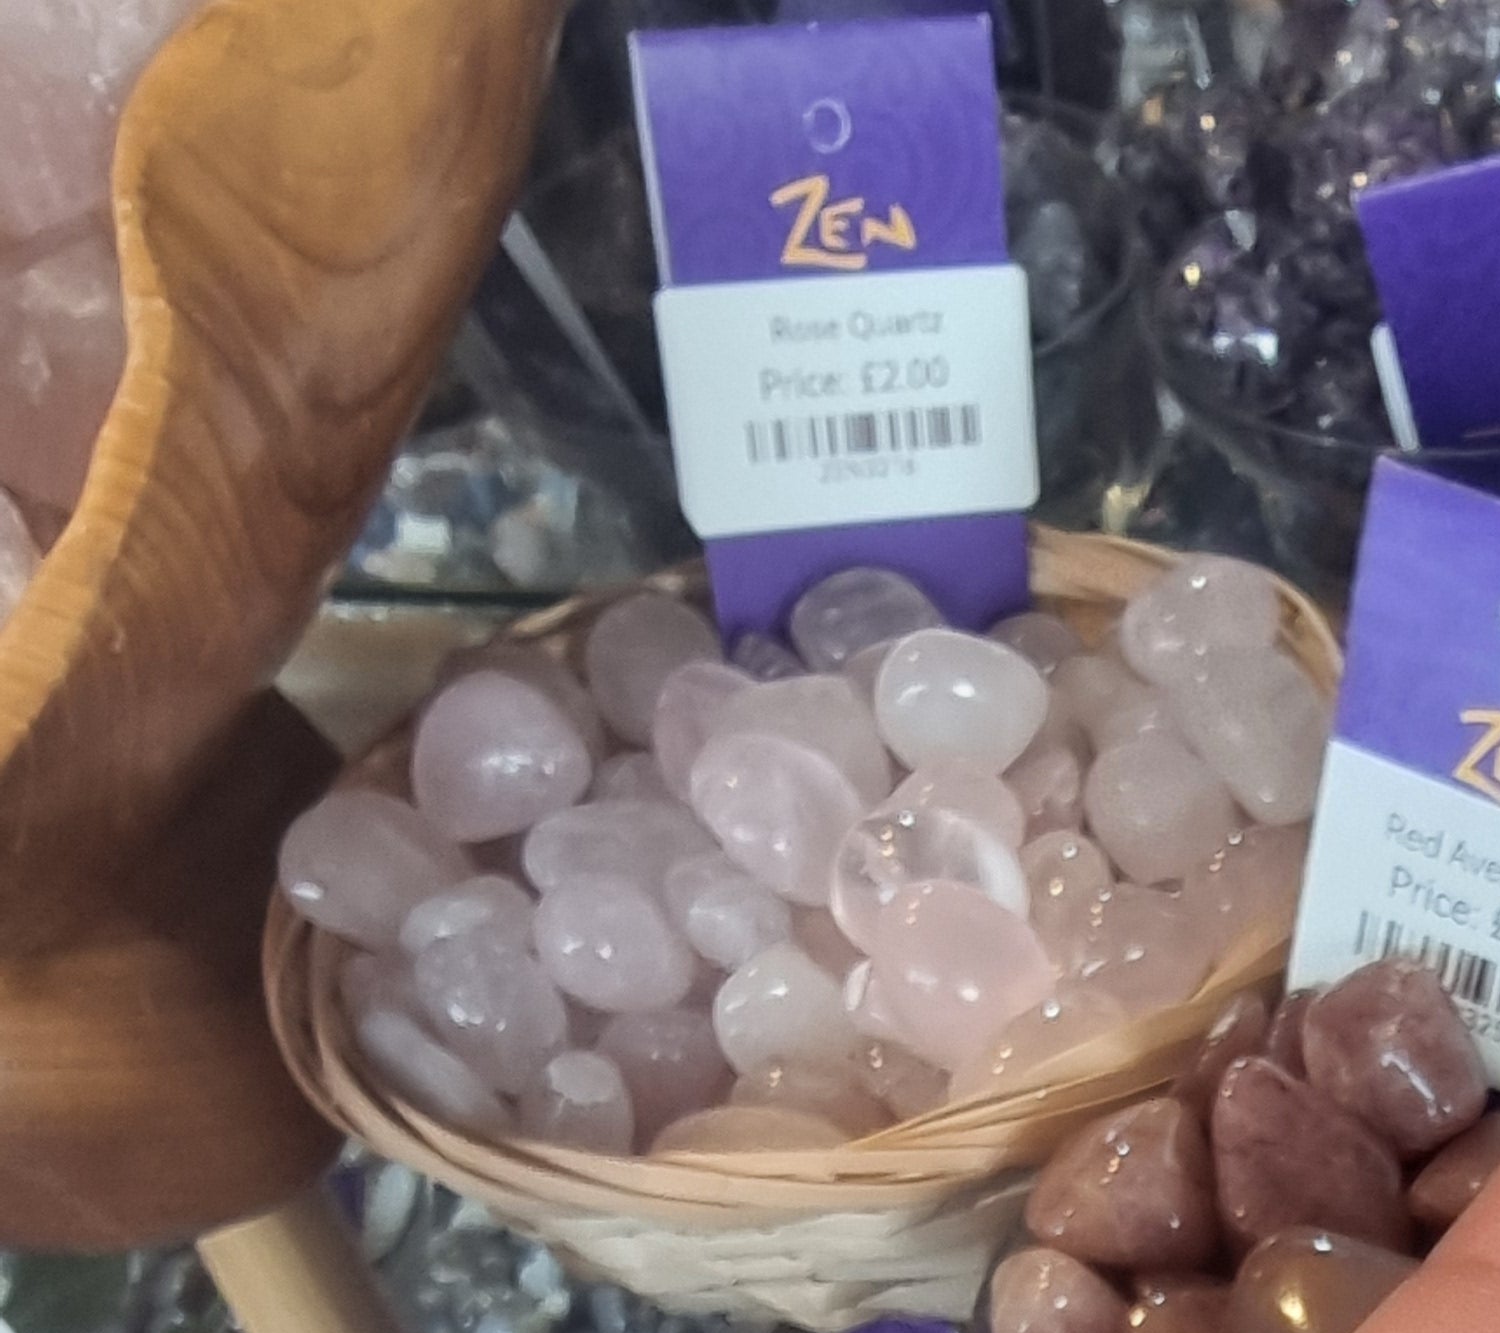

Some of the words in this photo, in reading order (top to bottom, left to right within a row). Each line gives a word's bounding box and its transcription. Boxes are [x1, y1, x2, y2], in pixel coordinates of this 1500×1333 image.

[768, 174, 917, 271] ZEN
[769, 313, 841, 343] Rose
[848, 309, 944, 342] Quartz
[757, 366, 847, 400] Price:
[860, 354, 951, 393] £2.00
[1385, 812, 1444, 859] Red
[1390, 864, 1481, 929] Price:
